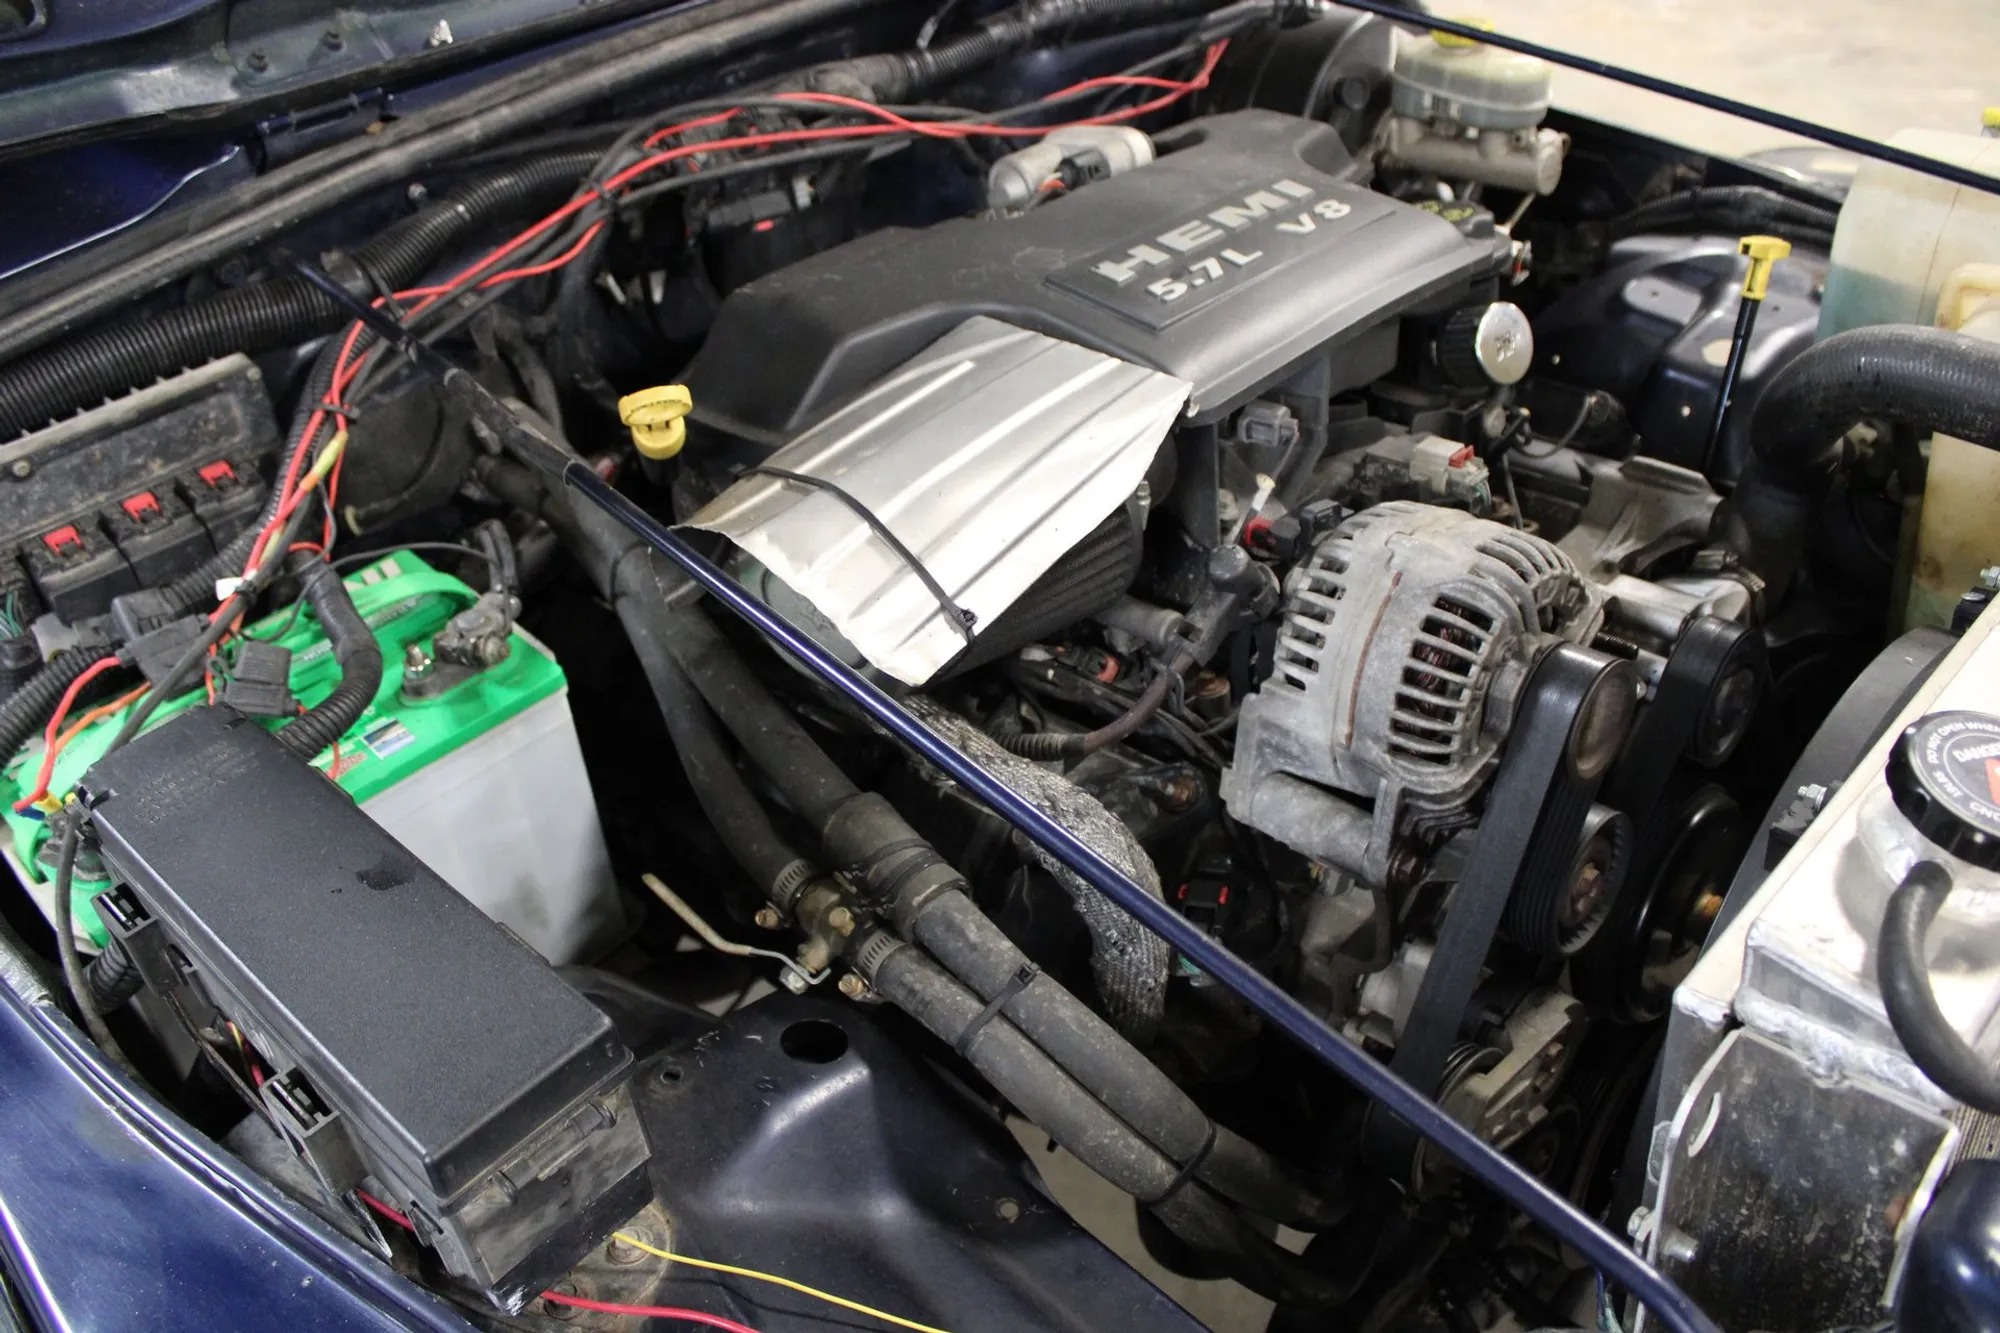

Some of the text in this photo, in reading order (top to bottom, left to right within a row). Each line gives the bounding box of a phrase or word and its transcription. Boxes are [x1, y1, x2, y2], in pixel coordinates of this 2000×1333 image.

[1090, 179, 1315, 284] HEMI
[1145, 199, 1351, 302] 5.7L V8
